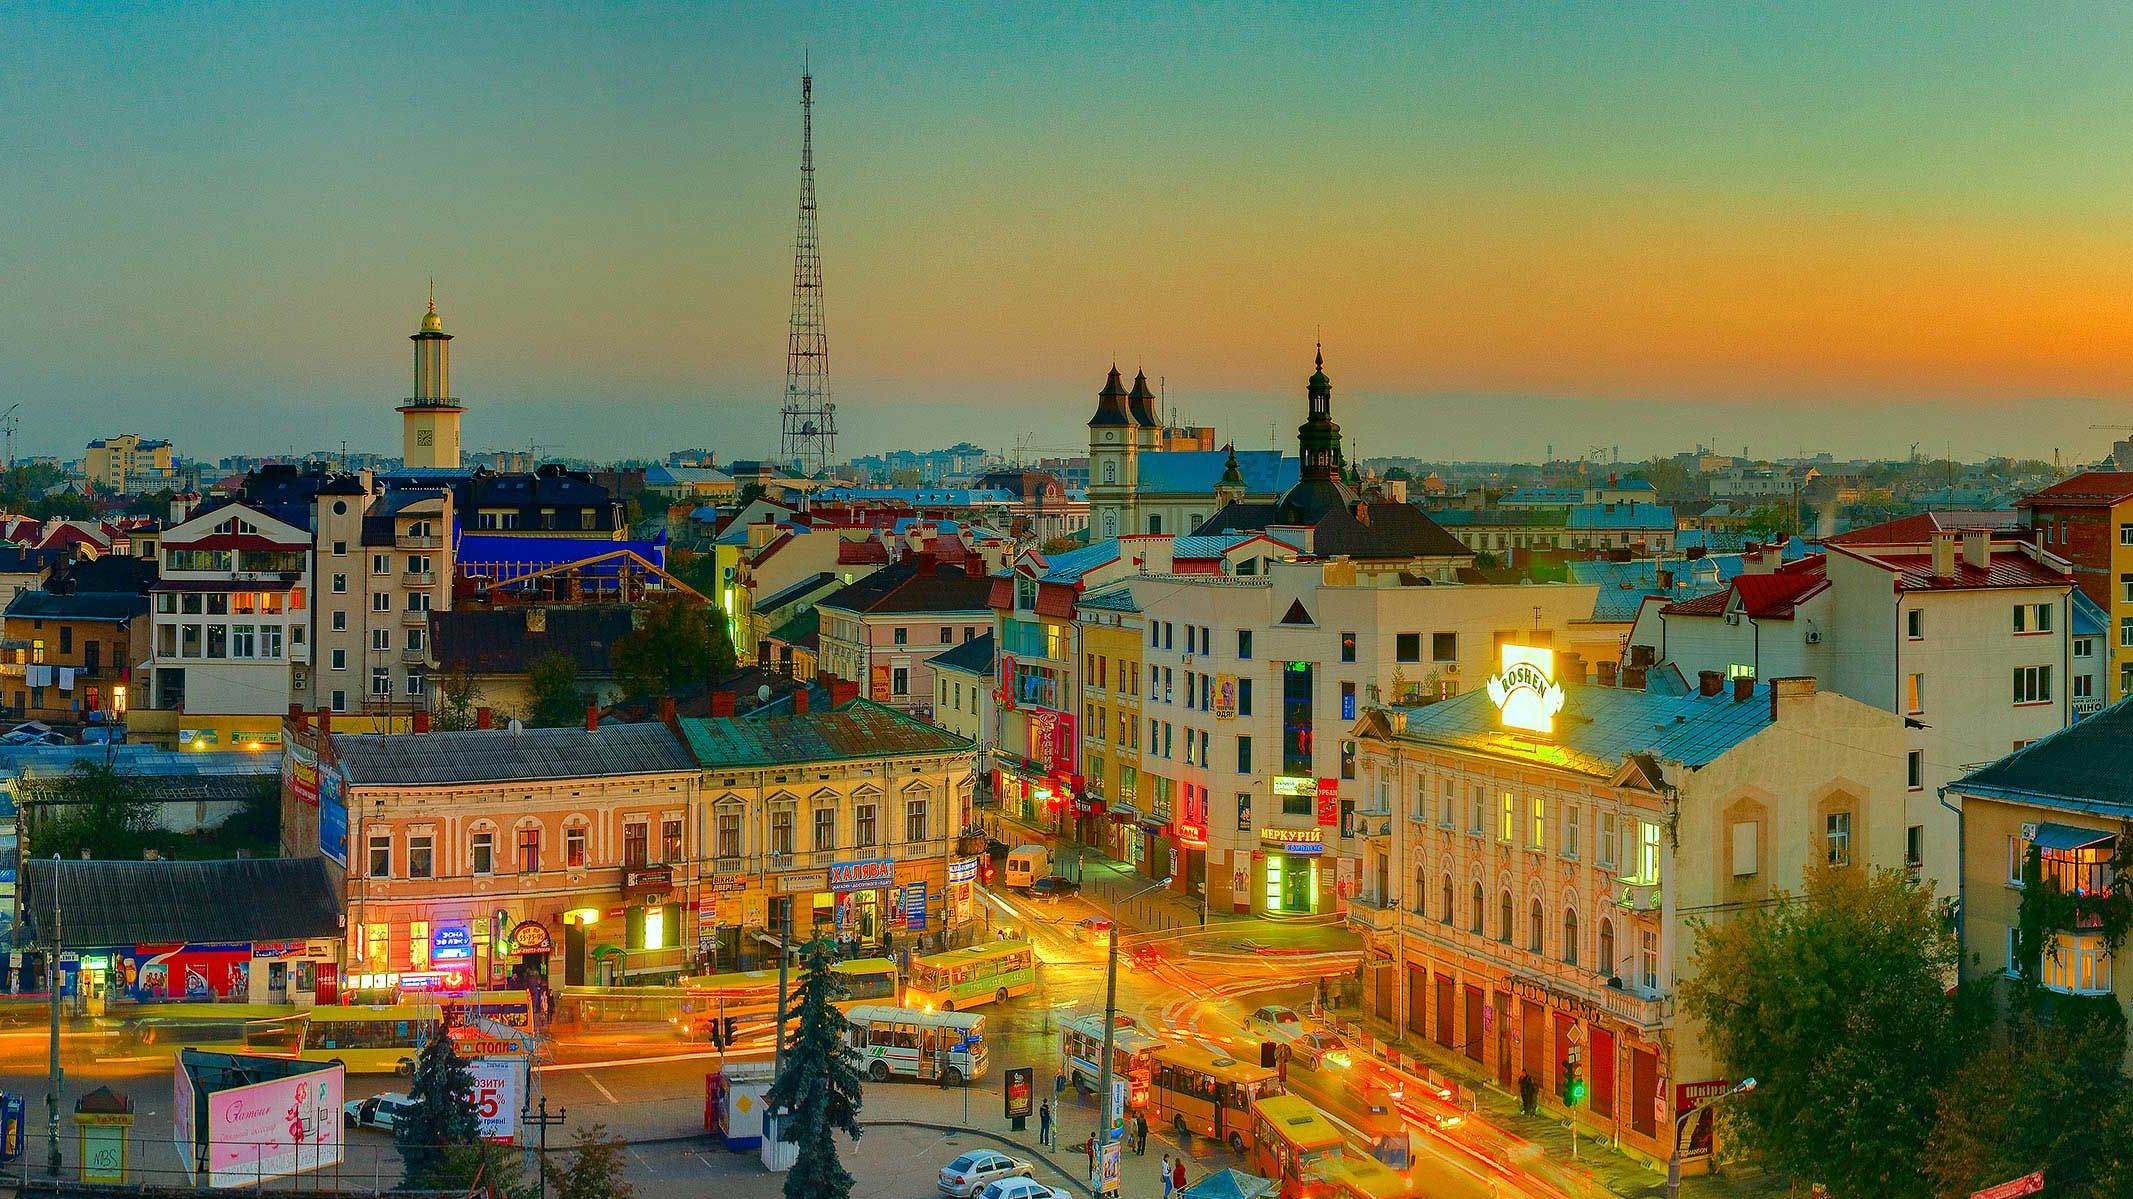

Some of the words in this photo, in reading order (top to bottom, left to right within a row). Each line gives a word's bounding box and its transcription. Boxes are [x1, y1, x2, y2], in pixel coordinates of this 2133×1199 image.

[1502, 667, 1547, 698] ROSHEN
[1261, 828, 1321, 842] МЕРКУРІЙ
[832, 862, 893, 883] ХАЛЯВА!
[475, 1079, 504, 1088] ОЗИТИ
